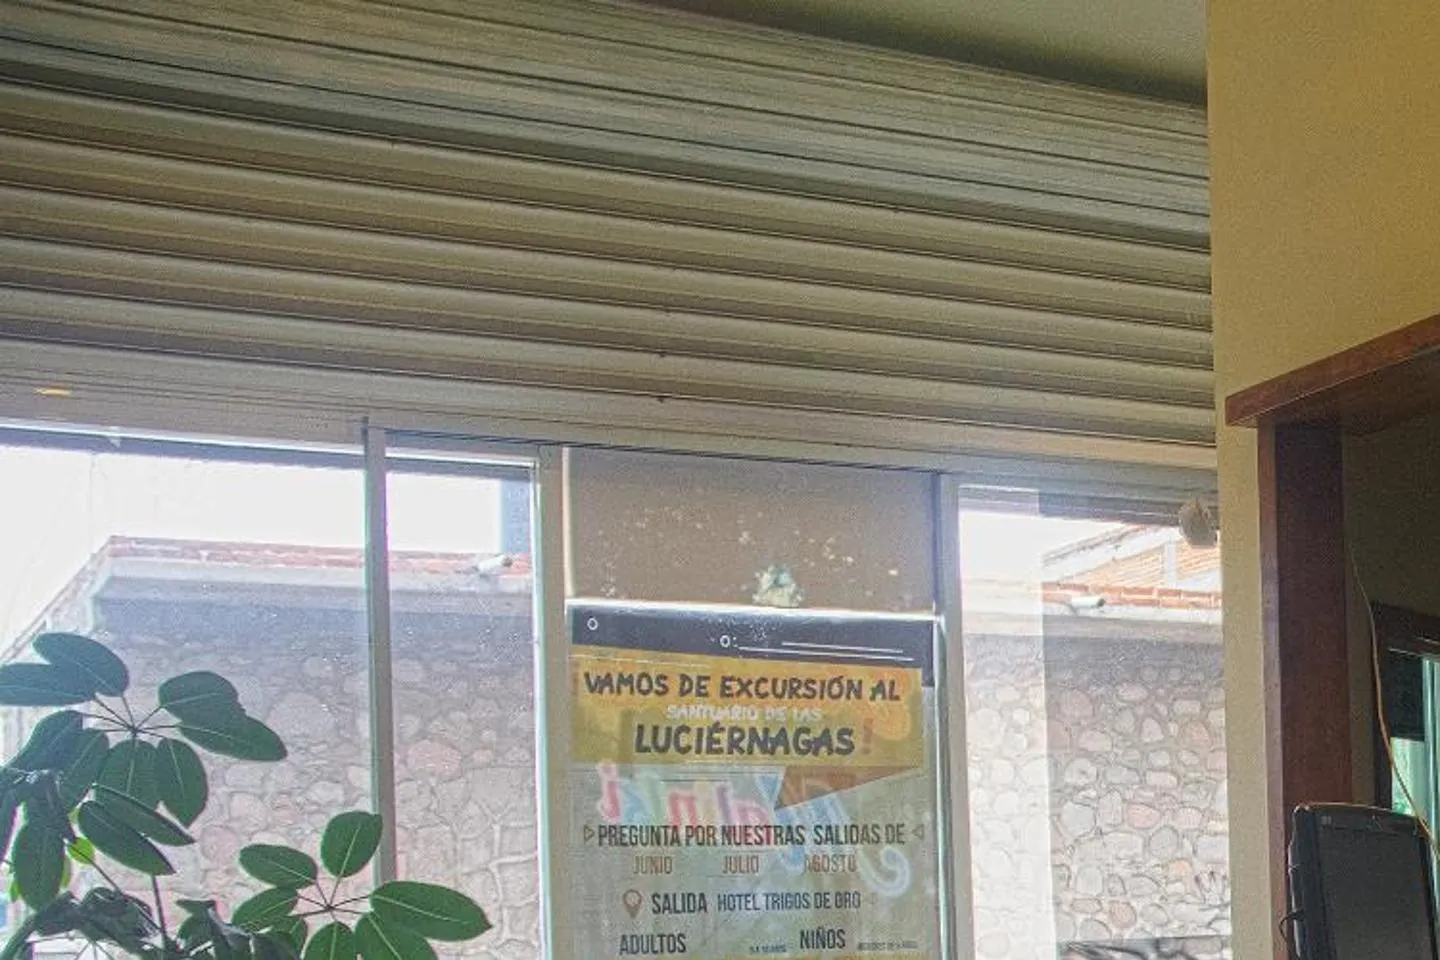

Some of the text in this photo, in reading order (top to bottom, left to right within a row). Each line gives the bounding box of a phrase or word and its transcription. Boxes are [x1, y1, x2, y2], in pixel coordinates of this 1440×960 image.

[584, 671, 901, 700] VAMOS DE EXCURSIÓN AL
[766, 706, 787, 721] DE
[598, 823, 906, 848] PREGUNTA POR NUESTRAS SALIDAS DE
[632, 855, 673, 875] JUNIO
[721, 854, 760, 875] JULIO
[651, 891, 862, 915] SALIDA HOTEL TRIGOS DE ORO
[618, 933, 687, 955] ADULTOS
[799, 928, 846, 950] NIÑOS
